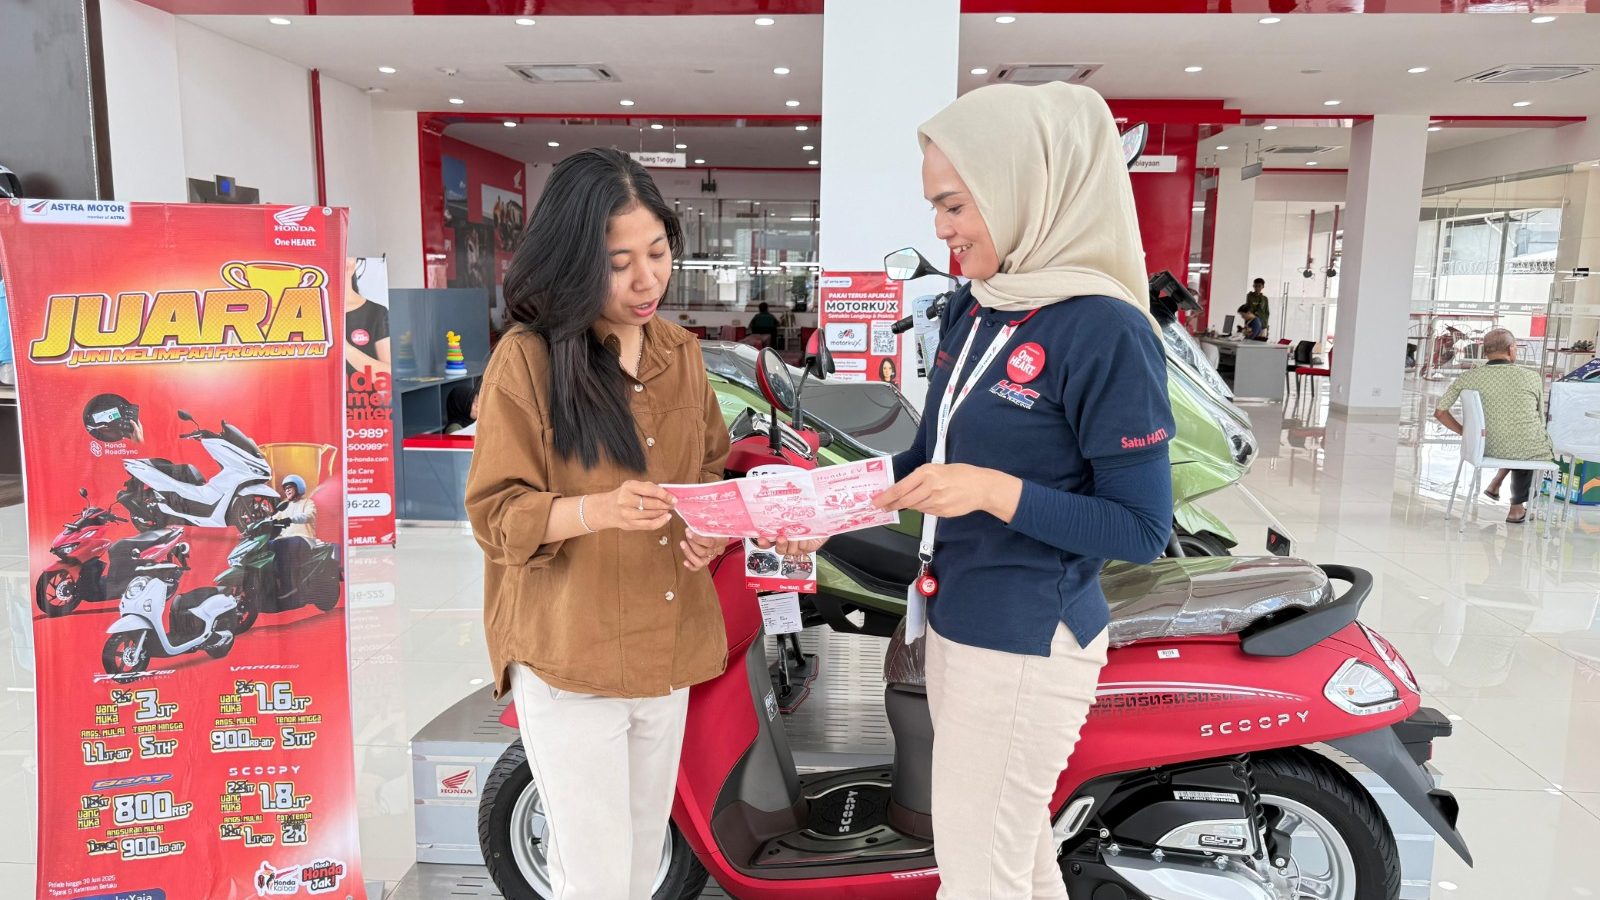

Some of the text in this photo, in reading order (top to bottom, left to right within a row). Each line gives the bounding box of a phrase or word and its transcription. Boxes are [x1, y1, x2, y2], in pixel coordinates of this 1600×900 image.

[1135, 160, 1160, 168] biayaan
[50, 203, 125, 212] ASTRA MOTOR
[275, 238, 290, 246] One
[826, 302, 896, 310] MOTORKU X
[30, 287, 326, 358] JUARA
[69, 344, 325, 364] JUNI MELIMPAH PROMONYA!
[1018, 350, 1034, 364] One
[347, 365, 392, 391] da
[1121, 436, 1145, 448] Satu
[298, 714, 322, 722] HINGGA
[158, 722, 184, 730] HINGGA
[1200, 710, 1309, 737] SCOOPY
[102, 728, 125, 736] MULAI
[228, 766, 300, 776] SCOOPY
[292, 812, 312, 820] TENOR
[838, 790, 858, 832] SCOOPY
[106, 827, 143, 836] ANGSURAN
[302, 864, 343, 882] Honda
[311, 876, 336, 890] Jak!
